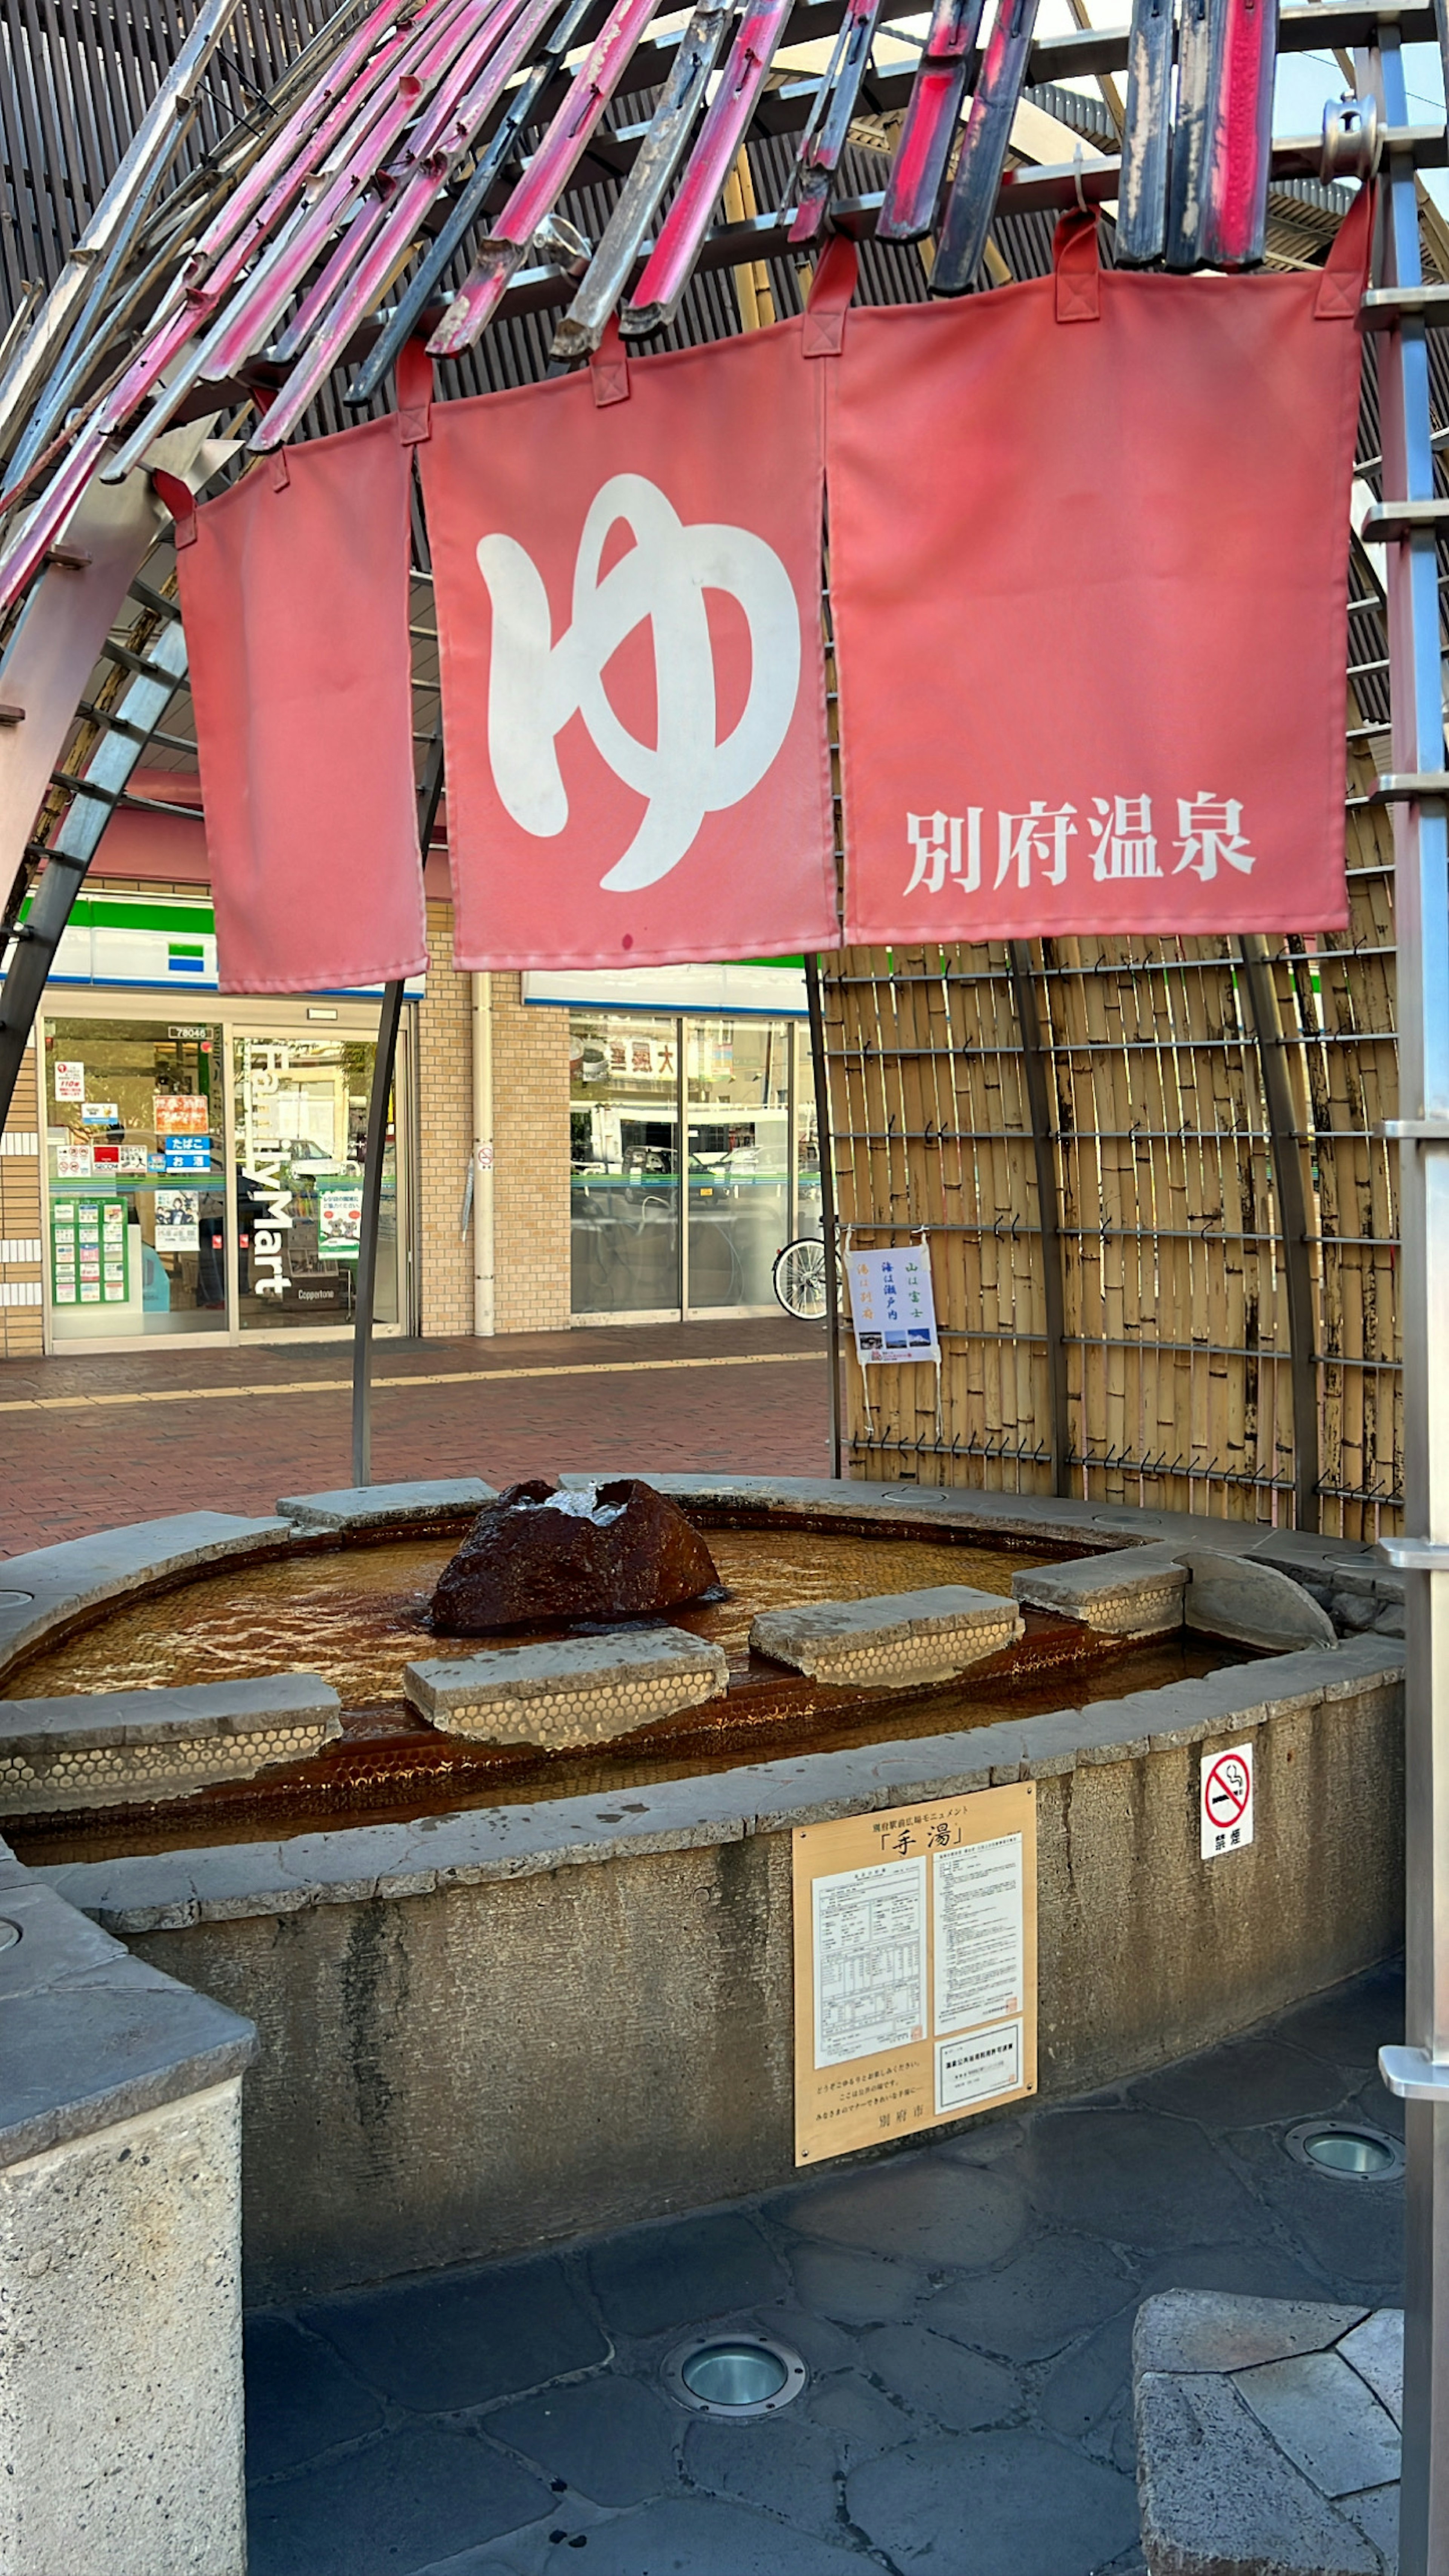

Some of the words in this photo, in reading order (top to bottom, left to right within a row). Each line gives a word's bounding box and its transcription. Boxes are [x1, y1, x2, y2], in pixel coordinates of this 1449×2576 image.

[476, 473, 801, 892] ゆ
[903, 791, 1256, 896] 別府温泉
[177, 1029, 206, 1037] 78046
[172, 1138, 203, 1149] たばこ
[173, 1156, 204, 1166] お酒
[242, 1045, 293, 1295] FamilyMart
[298, 1289, 334, 1301] Coppertone
[857, 1264, 873, 1319] 湯は別府
[881, 1262, 898, 1320] 海は瀬戸内
[906, 1263, 923, 1318] 山は富士
[1215, 1828, 1241, 1851] 禁煙
[879, 2105, 924, 2127] 別府市
